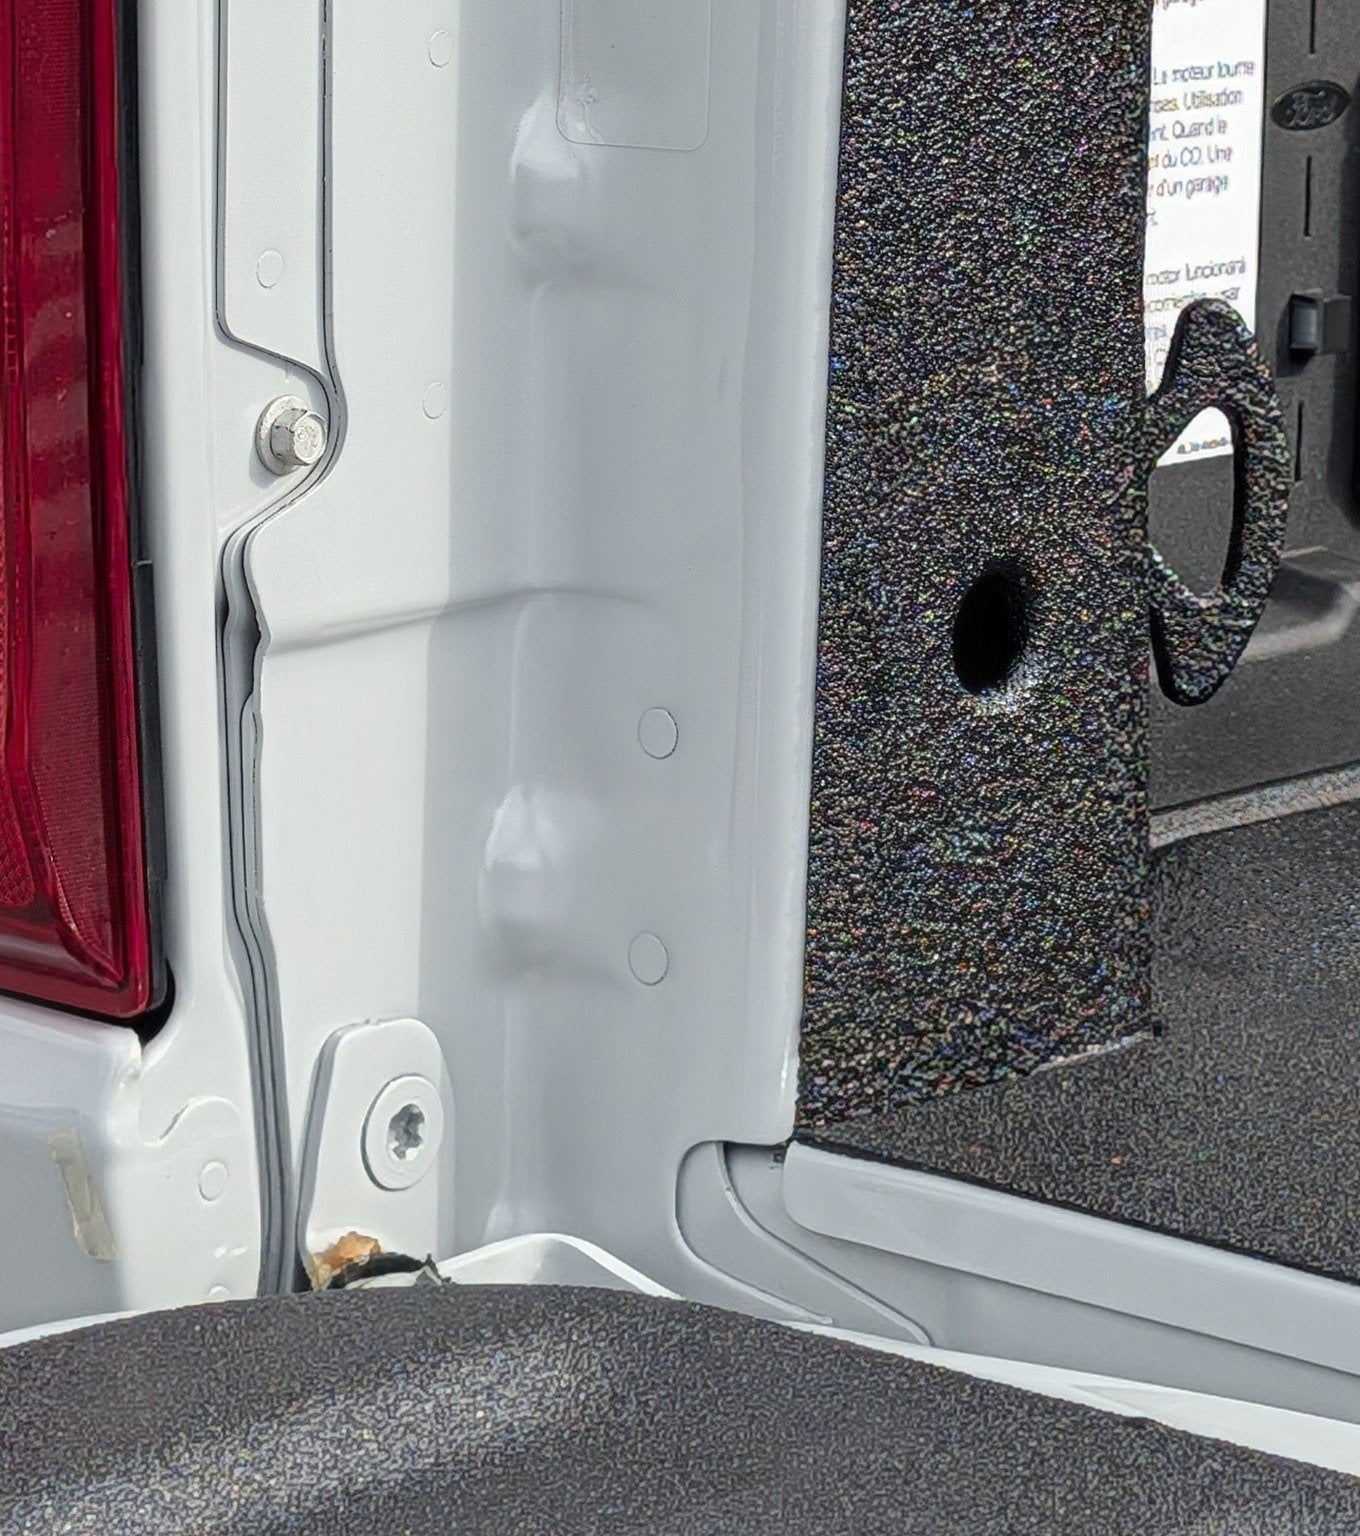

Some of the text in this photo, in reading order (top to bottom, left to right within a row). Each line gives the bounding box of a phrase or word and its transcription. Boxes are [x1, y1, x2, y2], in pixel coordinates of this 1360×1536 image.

[1153, 61, 1256, 86] Le moteur tourne
[1183, 87, 1244, 111] Utilisation
[1172, 115, 1214, 139] Quand
[1216, 114, 1229, 134] le
[1162, 149, 1178, 169] du
[1207, 143, 1234, 164] Une
[1156, 178, 1183, 197] d'un
[1185, 174, 1230, 200] garage
